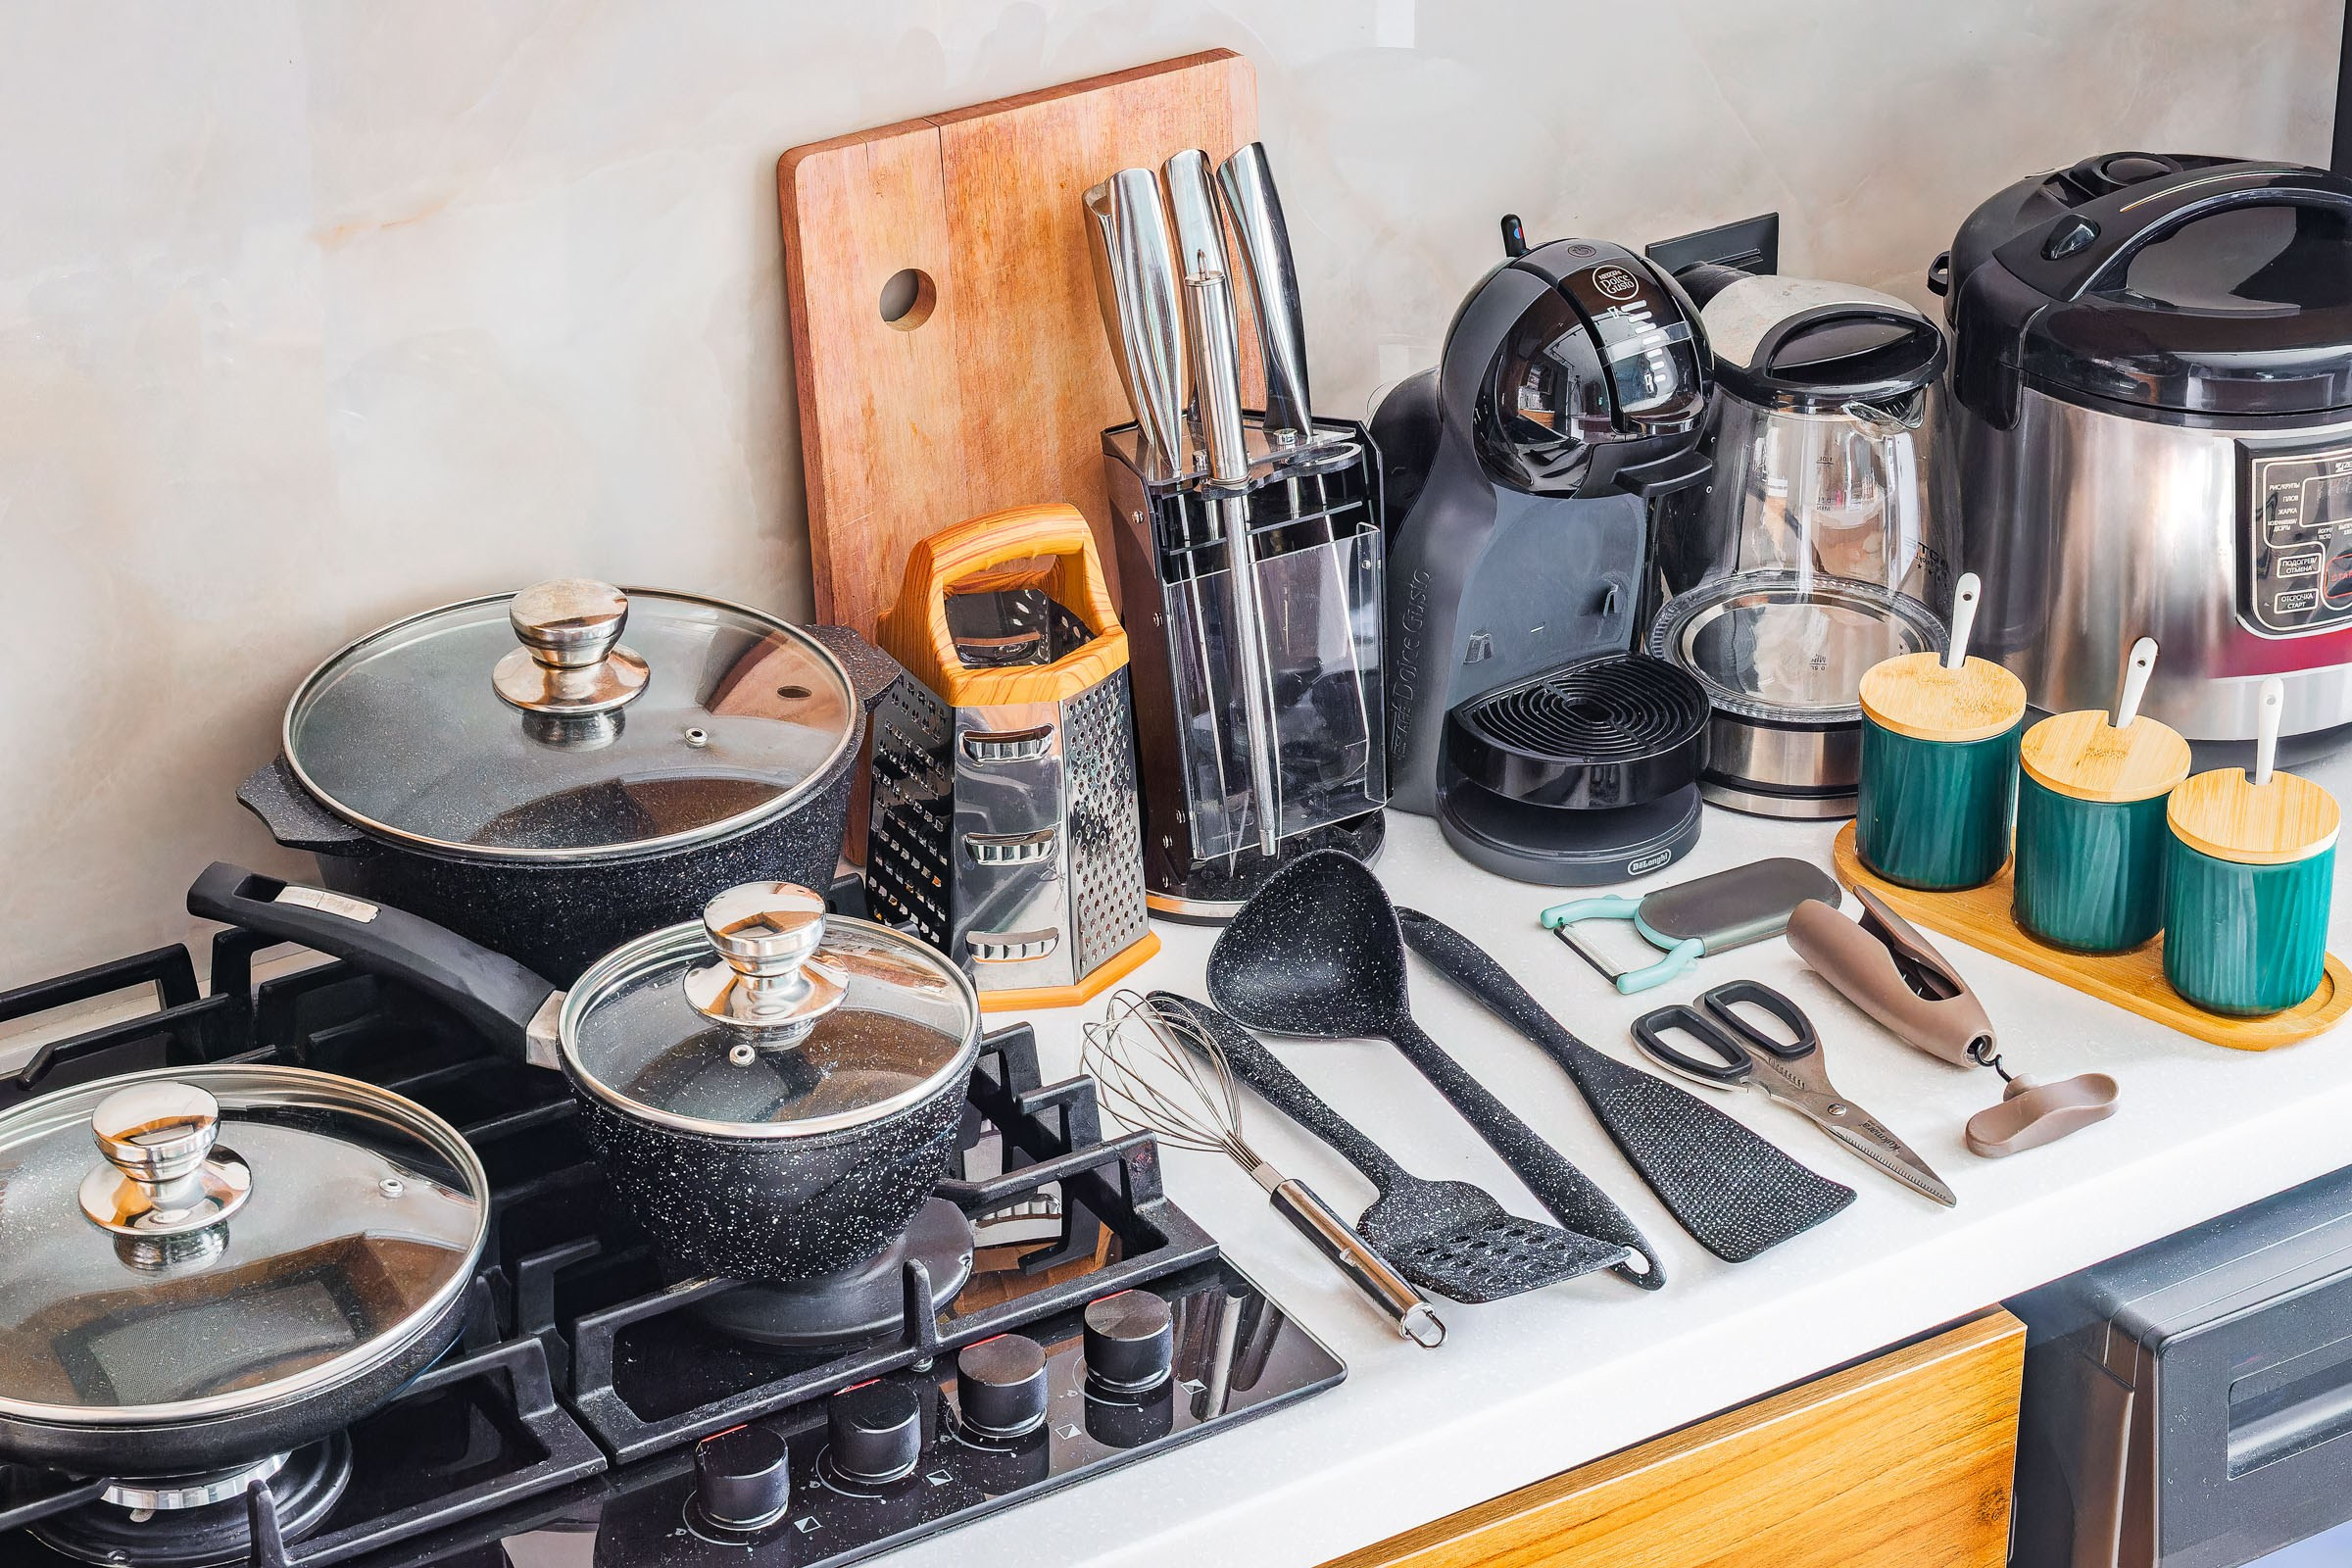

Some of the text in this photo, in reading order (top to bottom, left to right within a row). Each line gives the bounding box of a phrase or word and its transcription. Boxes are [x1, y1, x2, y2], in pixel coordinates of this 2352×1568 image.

[1599, 274, 1630, 288] Dolce
[1606, 281, 1635, 293] Gusto
[2282, 557, 2318, 567] ПОДОГРЕВ/
[2285, 565, 2313, 574] ОТМЕНА
[2280, 592, 2314, 603] ОТСРОЧКА
[2286, 601, 2307, 610] СТАРТ
